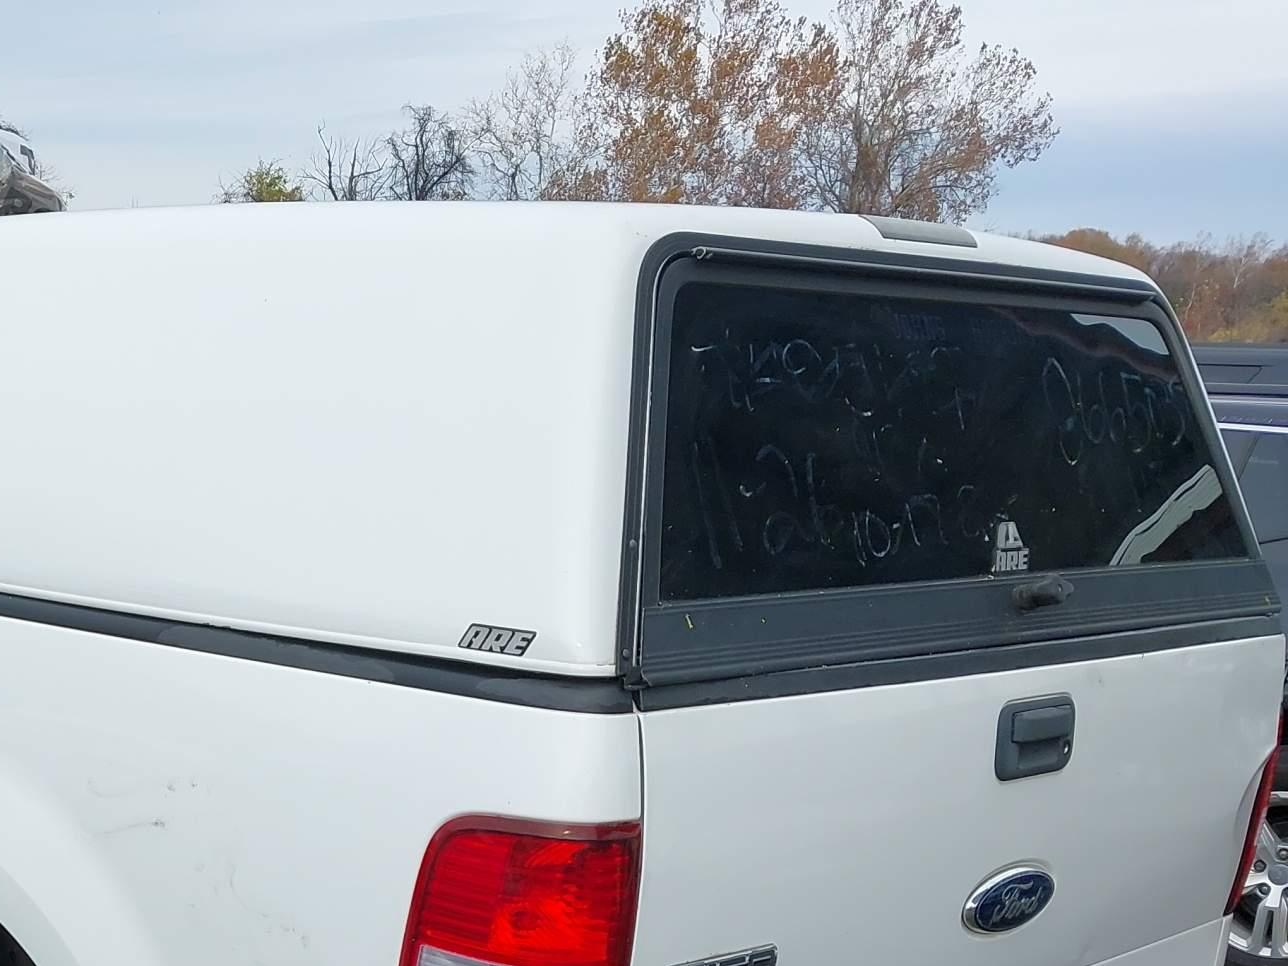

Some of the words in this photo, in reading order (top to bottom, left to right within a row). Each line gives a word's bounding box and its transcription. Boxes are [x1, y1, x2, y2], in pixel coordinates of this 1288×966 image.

[995, 548, 1030, 572] ARE
[459, 624, 534, 656] ARE
[988, 879, 1043, 929] Ford
